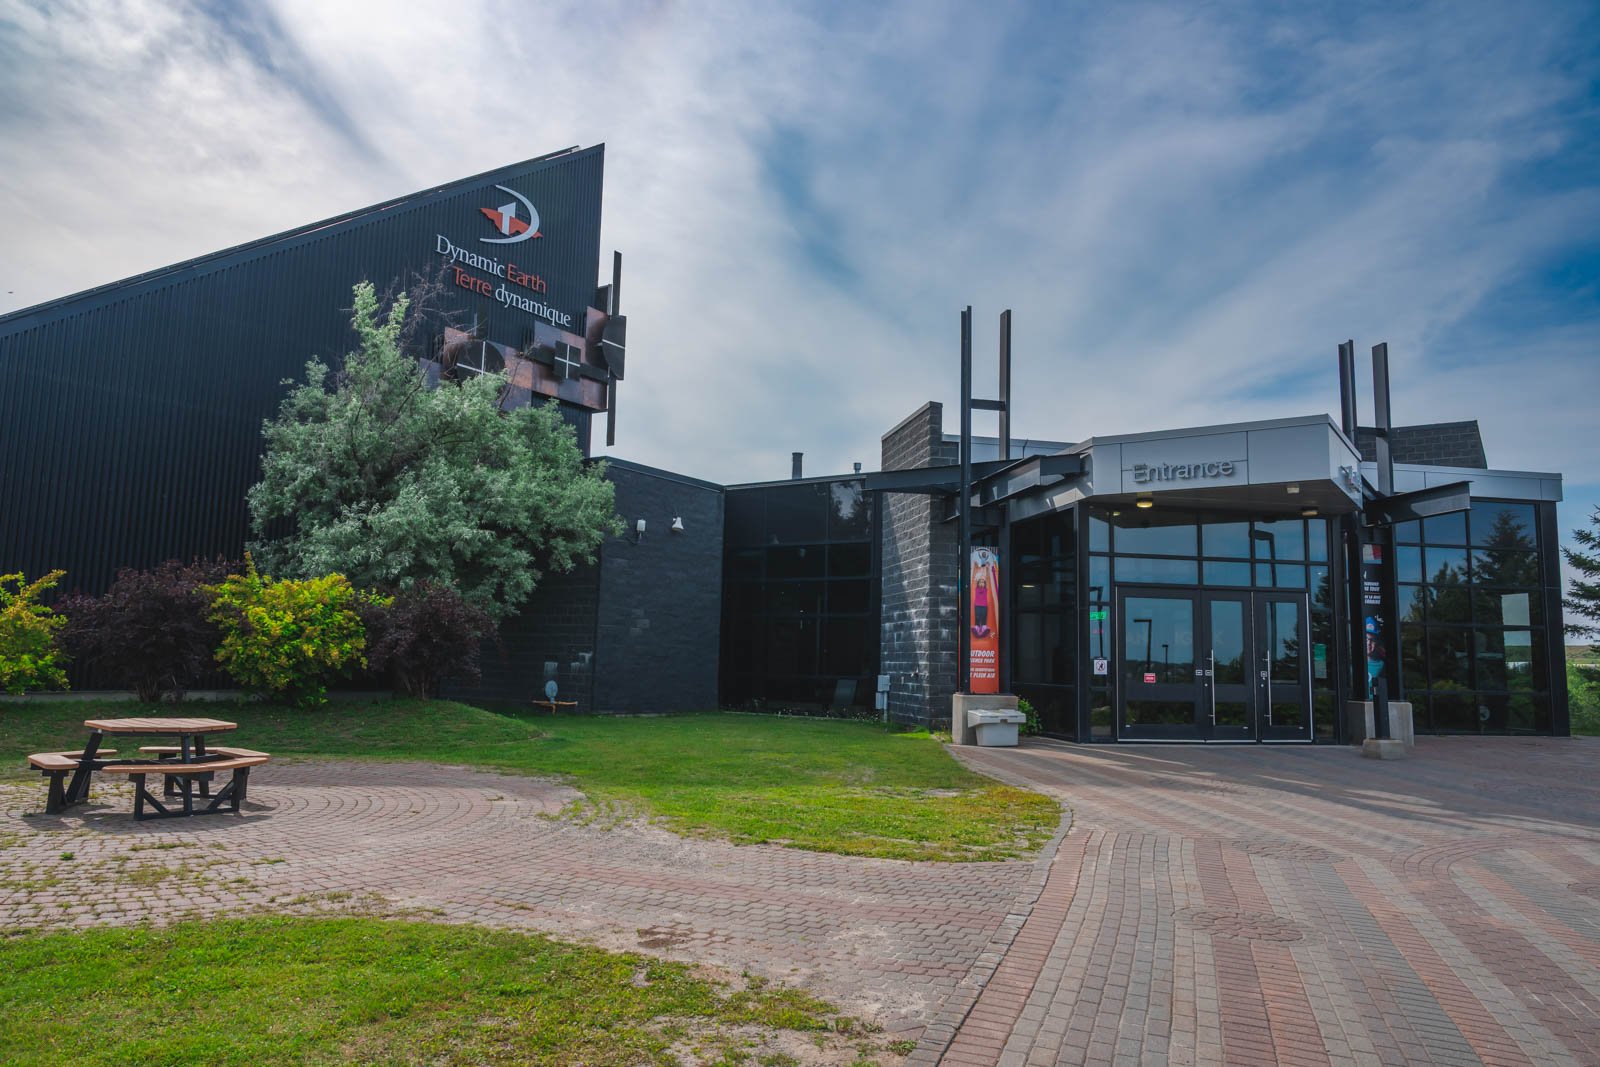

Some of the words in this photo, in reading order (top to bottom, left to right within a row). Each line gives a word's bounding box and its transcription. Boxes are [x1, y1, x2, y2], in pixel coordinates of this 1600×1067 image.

[436, 234, 505, 278] Dynamic
[507, 263, 547, 295] Earth
[452, 266, 493, 297] Terre
[495, 284, 571, 327] dynamique
[1134, 461, 1233, 483] Entrance
